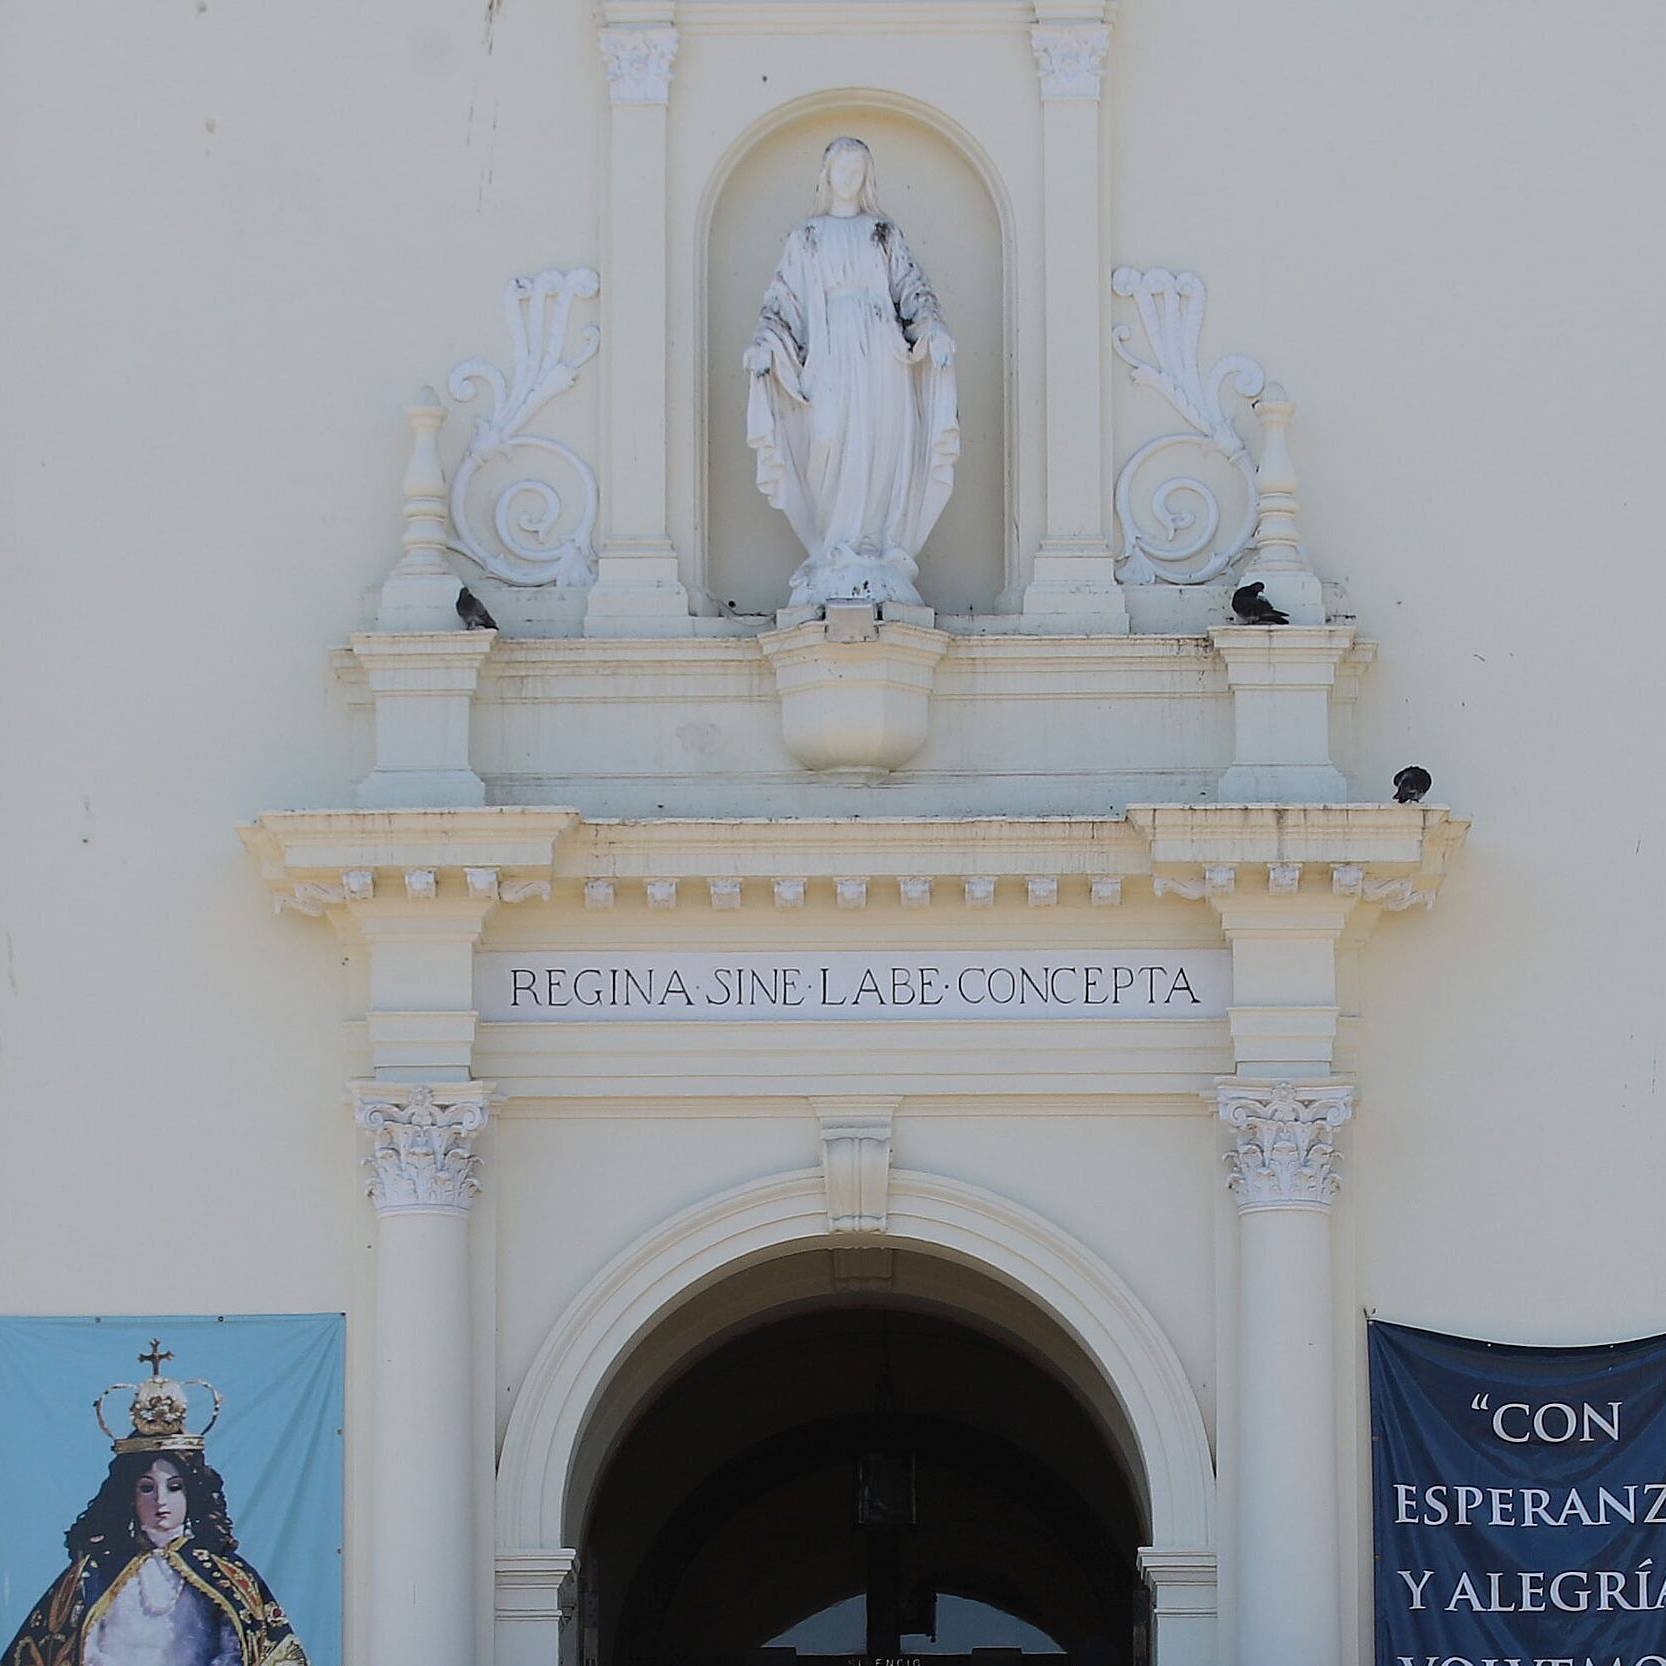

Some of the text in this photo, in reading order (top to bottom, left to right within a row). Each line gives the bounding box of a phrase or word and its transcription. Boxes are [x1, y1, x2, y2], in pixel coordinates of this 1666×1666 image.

[510, 965, 1201, 1006] REGINA SINE LABE CONCEPTA
[1398, 1570, 1432, 1610] Y
